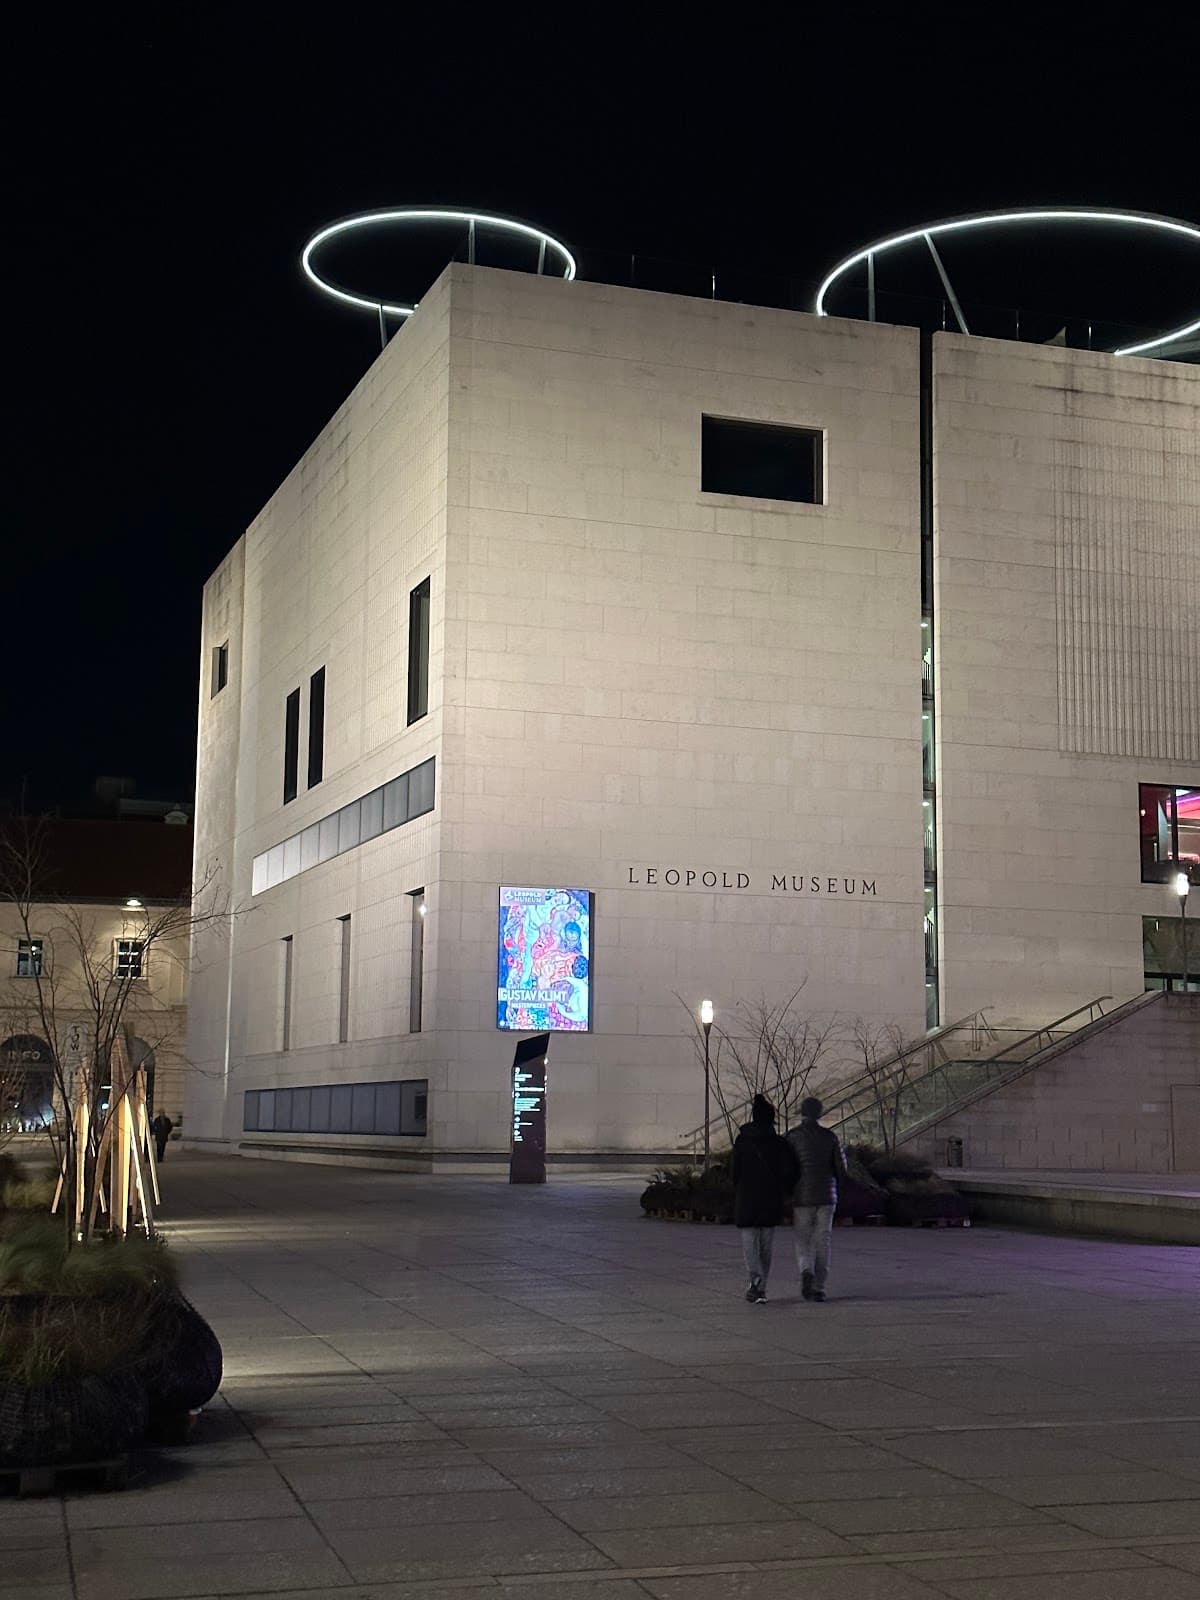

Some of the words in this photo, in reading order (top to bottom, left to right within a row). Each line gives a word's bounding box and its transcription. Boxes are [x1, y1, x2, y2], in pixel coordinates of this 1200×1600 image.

[628, 867, 750, 889] LEOPOLD
[772, 875, 877, 896] MUSEUM
[500, 990, 536, 1001] GUSTAV
[538, 991, 567, 1002] KLIMT
